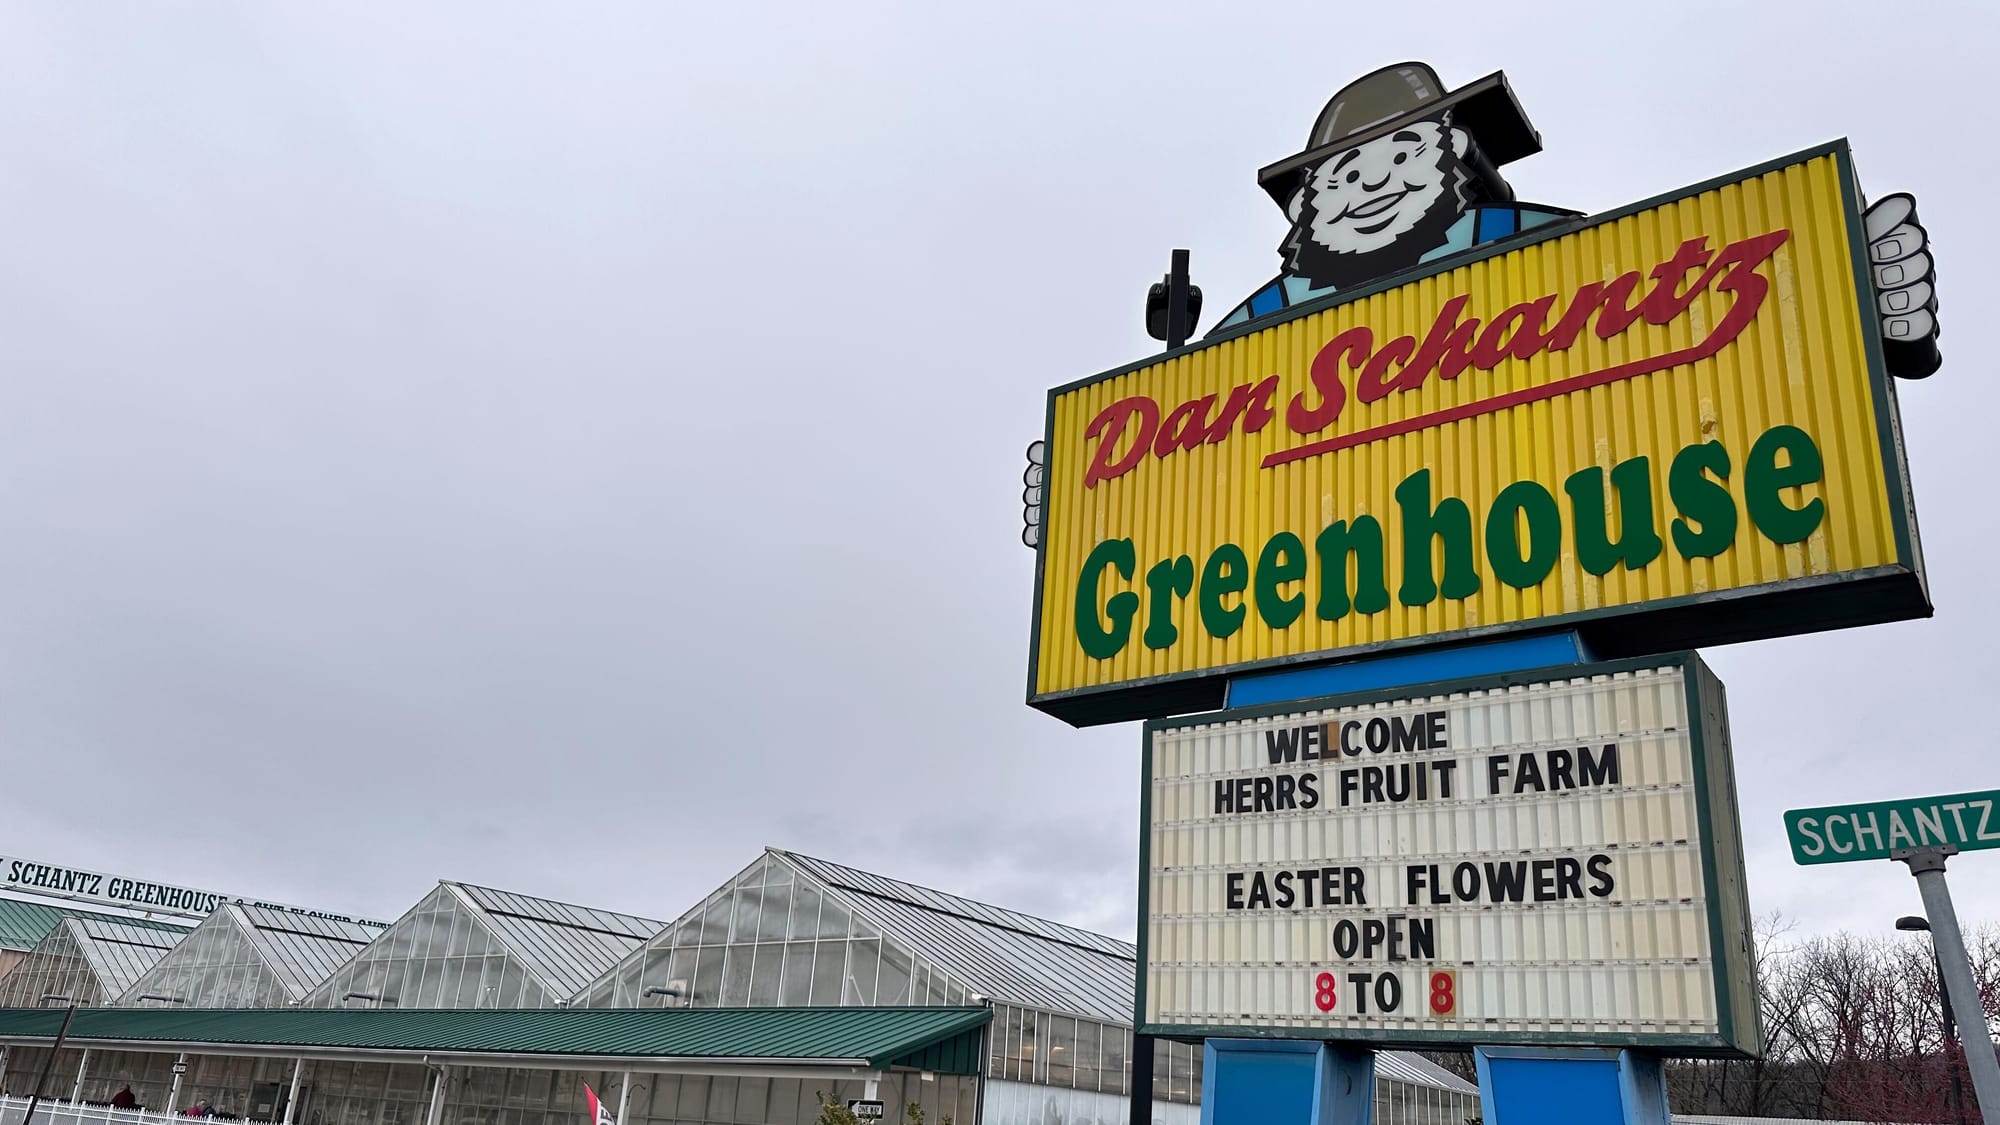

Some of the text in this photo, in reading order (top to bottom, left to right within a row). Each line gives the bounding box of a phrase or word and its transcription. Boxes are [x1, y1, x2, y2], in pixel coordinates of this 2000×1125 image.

[1085, 229, 1790, 488] Dan Schantz
[1075, 426, 1825, 660] Greenhouse
[1265, 711, 1447, 765] WELCOME
[1214, 744, 1619, 815] HERRS FRUIT FARM
[1797, 800, 2000, 856] SCHANTZ
[8, 860, 102, 895] SCHANTZ
[1226, 854, 1615, 910] EASTER FLOWERS
[1332, 914, 1435, 964] OPEN
[1315, 972, 1455, 1016] 8 TO 8
